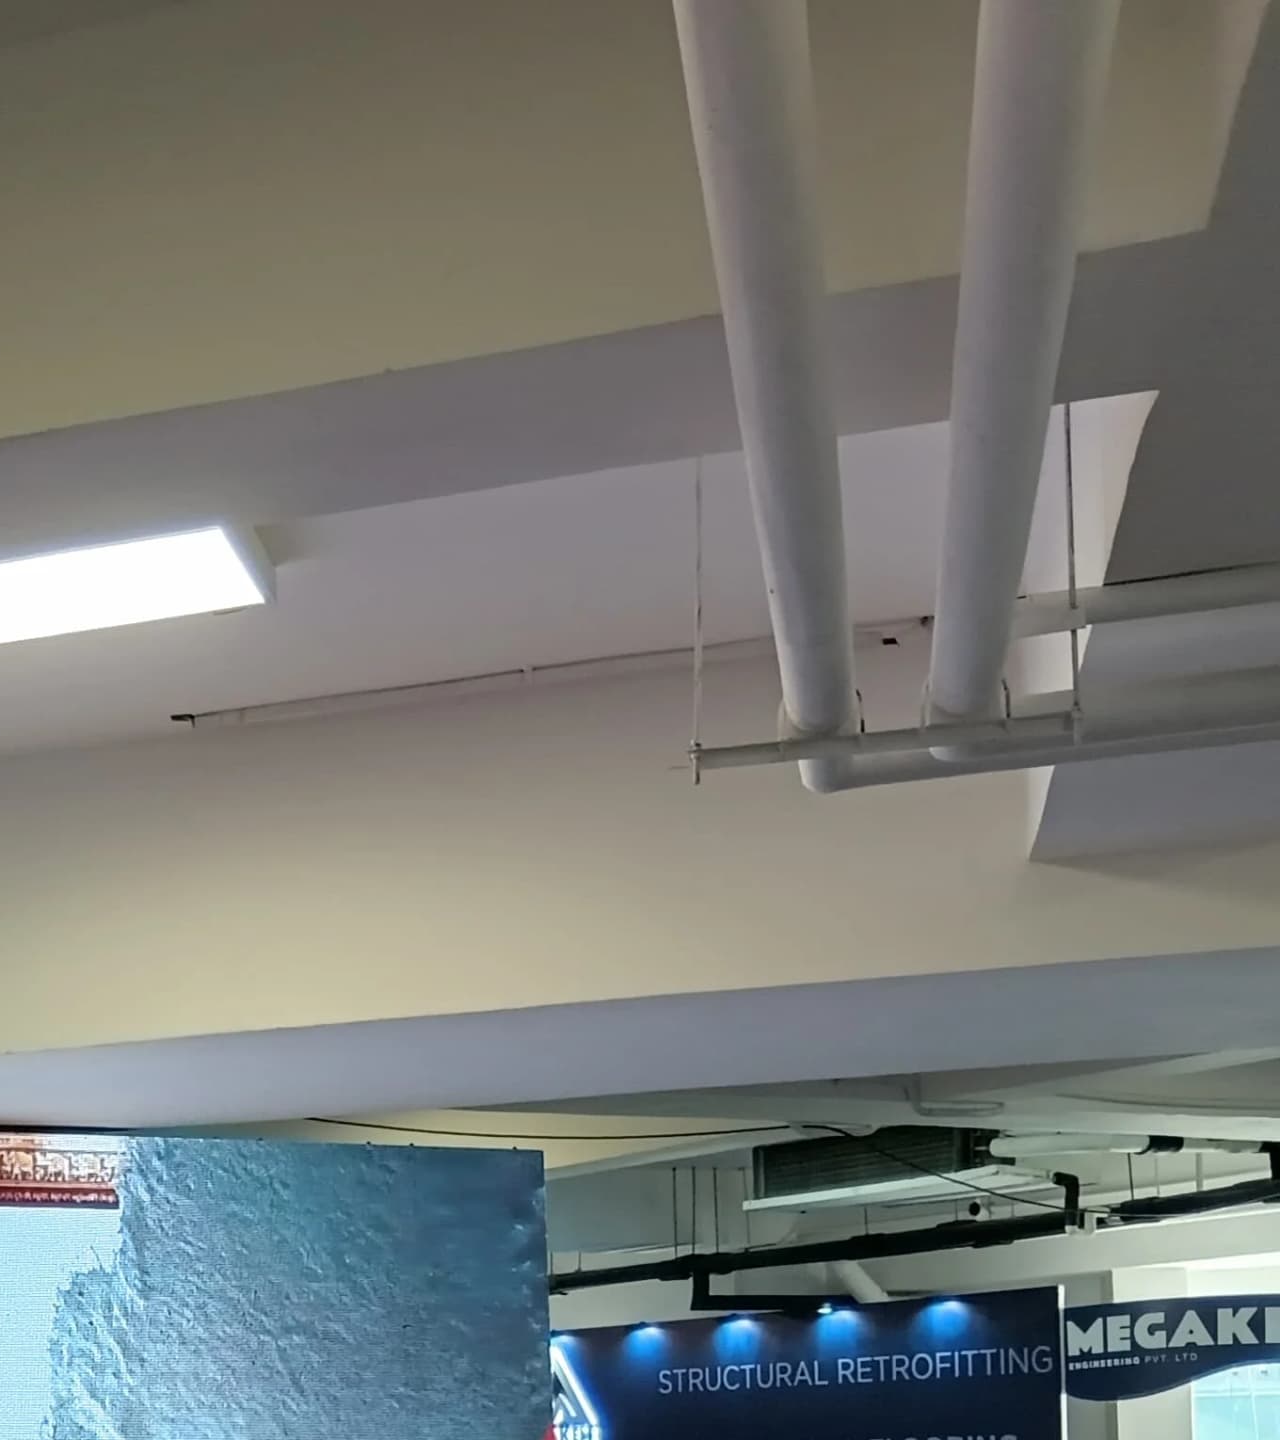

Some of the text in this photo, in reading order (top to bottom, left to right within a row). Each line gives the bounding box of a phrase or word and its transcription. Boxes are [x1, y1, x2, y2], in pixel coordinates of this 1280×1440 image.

[658, 1345, 1054, 1394] STRUCTURAL RETROFITTING
[1068, 1357, 1140, 1371] ENGINEERING
[1175, 1352, 1198, 1362] LTD
